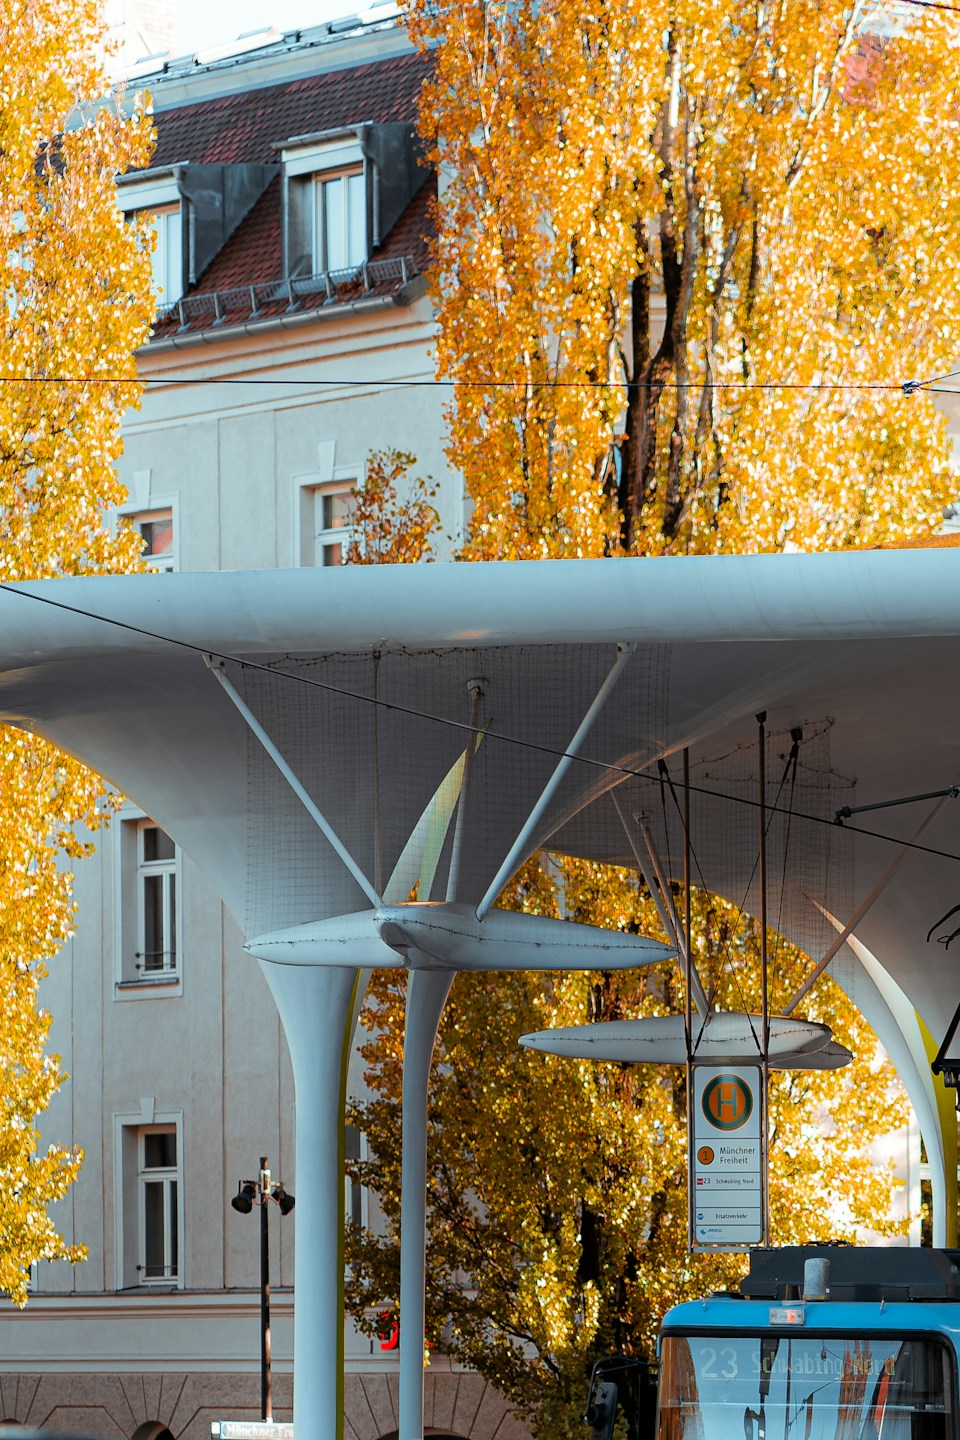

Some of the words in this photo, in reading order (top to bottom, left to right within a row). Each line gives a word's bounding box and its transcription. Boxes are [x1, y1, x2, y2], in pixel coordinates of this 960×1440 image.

[719, 1146, 756, 1155] Münchner
[703, 1151, 709, 1160] 1
[719, 1156, 748, 1164] Freiheit
[700, 1348, 738, 1378] 23
[752, 1351, 845, 1379] Schwabing
[226, 1424, 274, 1437] Münchner
[278, 1425, 294, 1438] Fre
